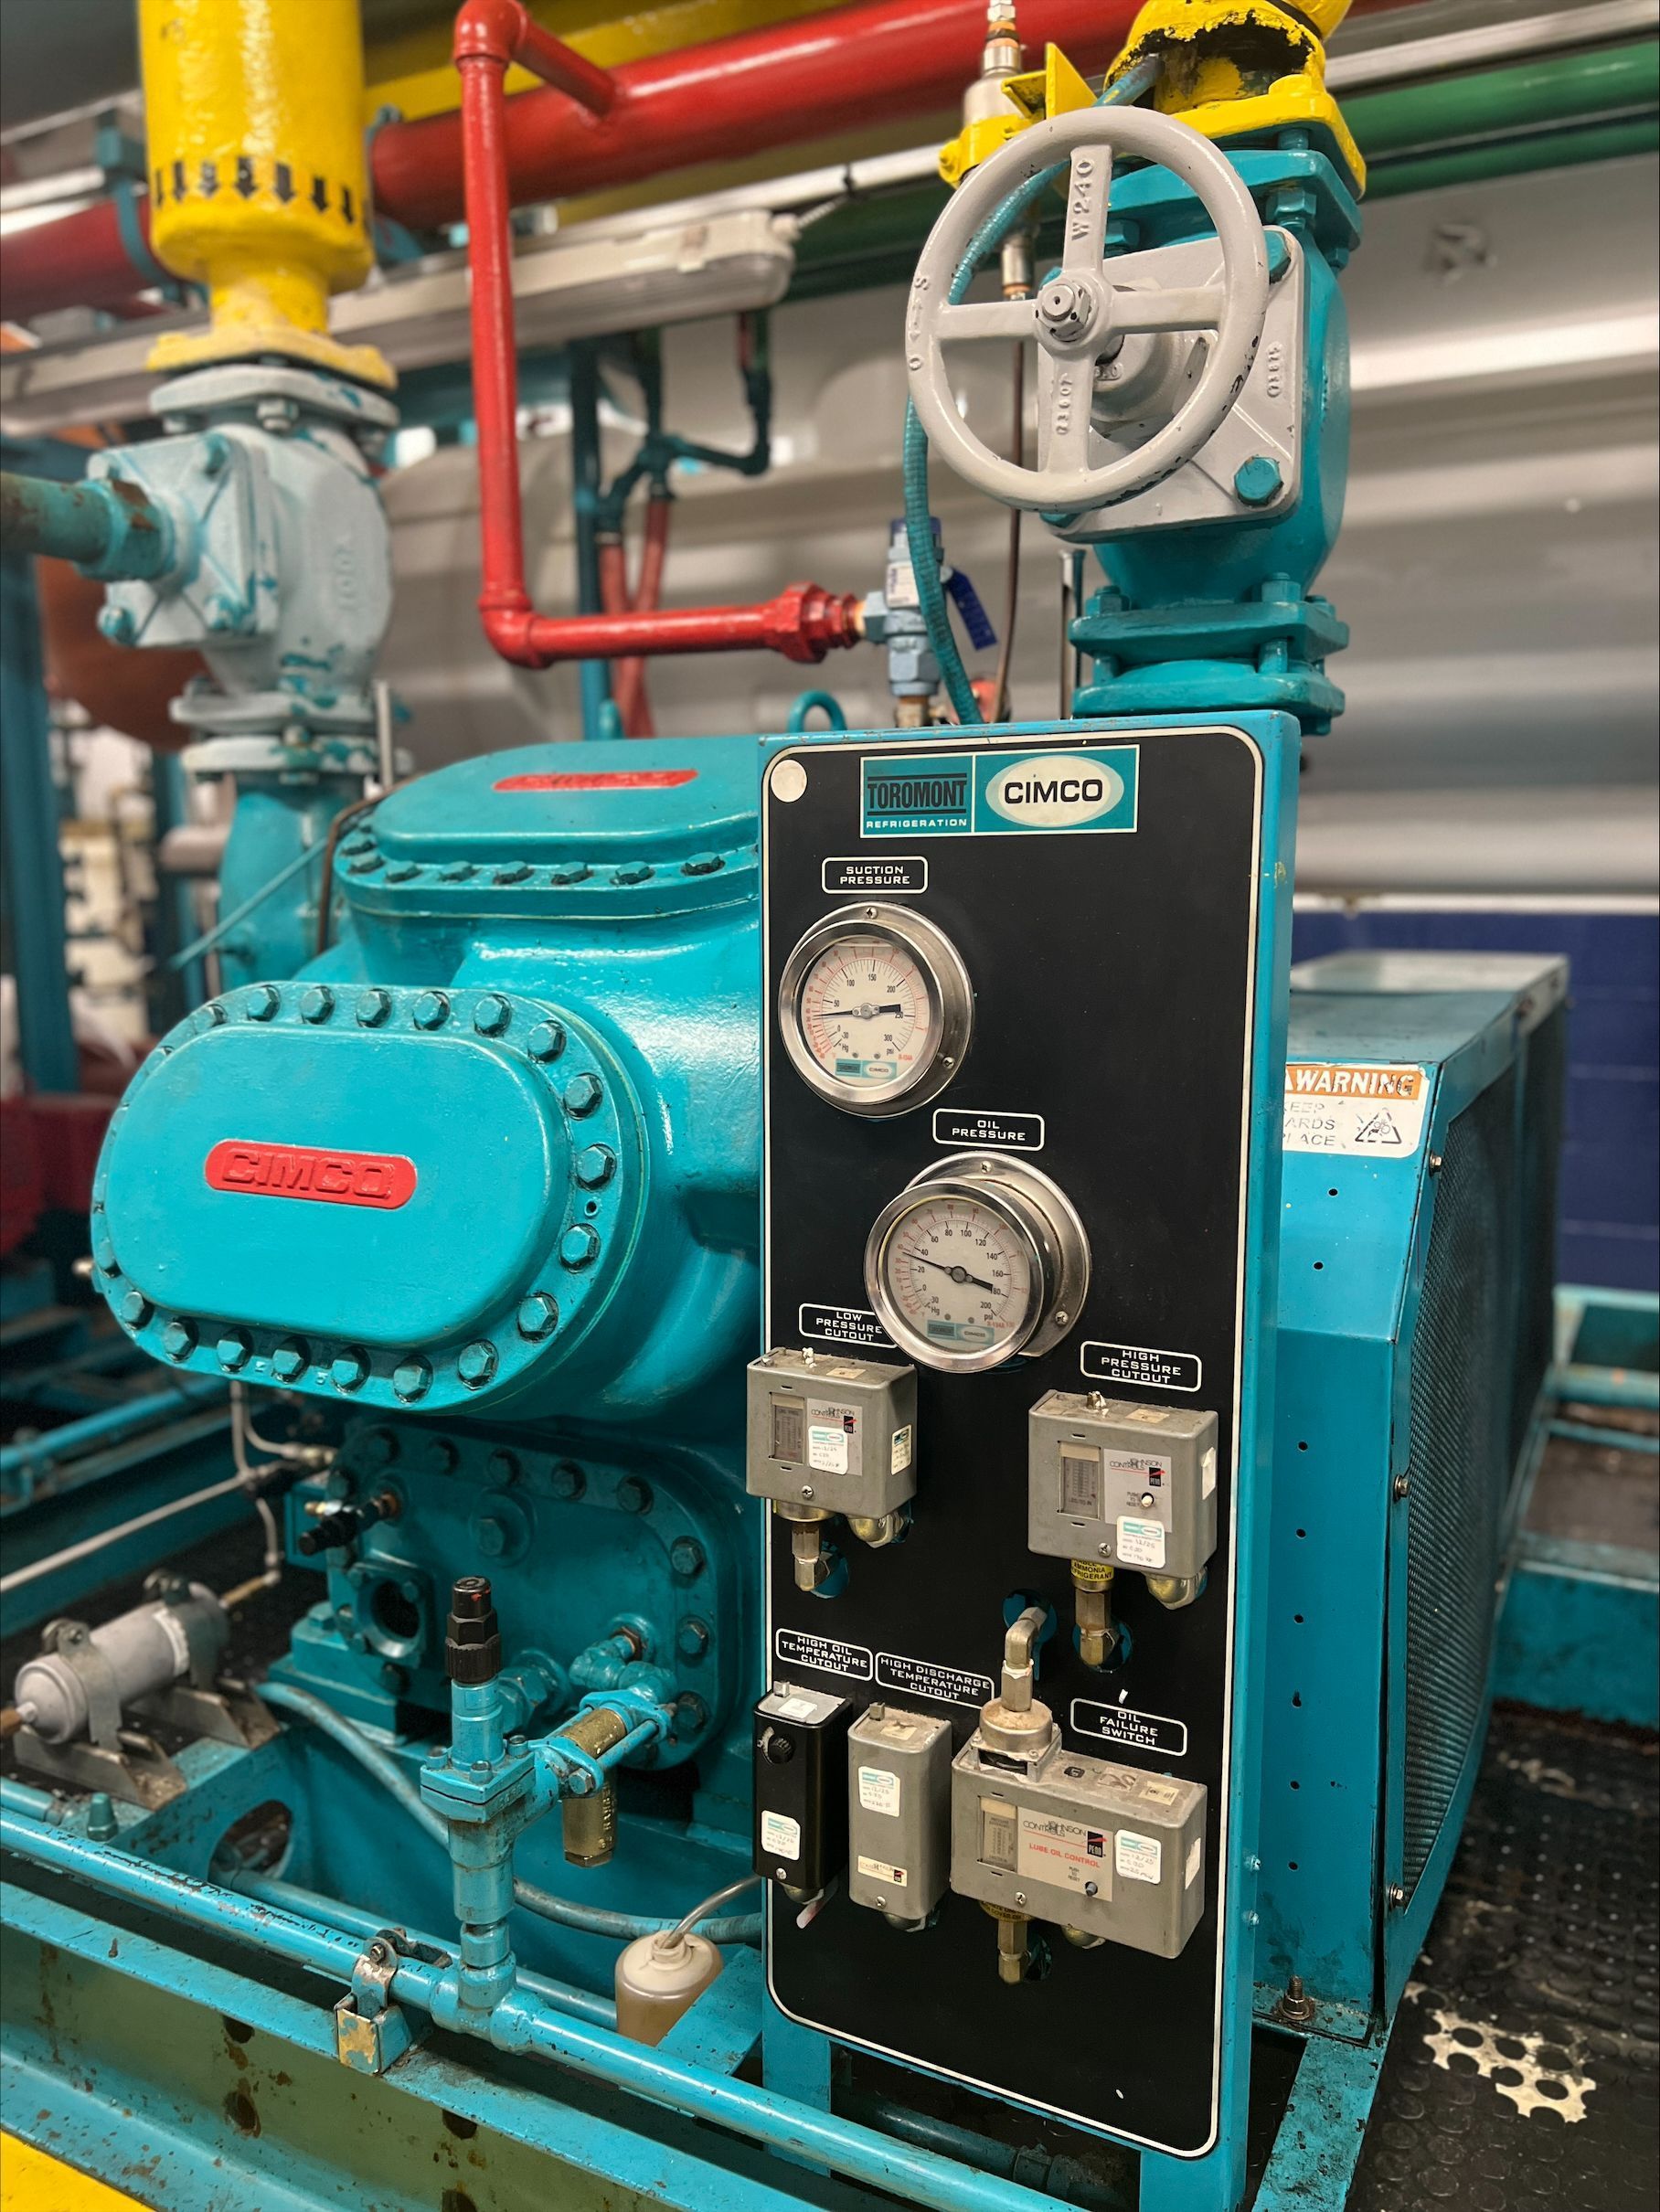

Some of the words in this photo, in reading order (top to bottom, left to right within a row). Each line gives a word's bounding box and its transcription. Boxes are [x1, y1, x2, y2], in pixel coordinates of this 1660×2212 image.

[1071, 159, 1094, 240] W240
[867, 781, 967, 809] TOROMONT
[1005, 779, 1102, 804] CIMCO
[867, 818, 967, 829] REFRIGERATION
[846, 866, 903, 875] SUCTION
[840, 876, 910, 885] PRESSURE
[1296, 1069, 1414, 1097] WARNING
[977, 1120, 1000, 1129] OIL
[952, 1128, 1026, 1141] PRESSURE
[222, 1148, 394, 1199] CIMCO
[816, 1317, 882, 1334] PRESSURE
[835, 1312, 862, 1321] LOW
[825, 1328, 874, 1341] CUTOUT
[1122, 1350, 1159, 1362] HIGH
[1101, 1356, 1181, 1376] PRESSURE
[1112, 1368, 1170, 1384] CUTOUT
[782, 1640, 867, 1668] TEMPERATURE
[797, 1636, 827, 1650] HIGH
[832, 1644, 852, 1655] OIL
[801, 1654, 848, 1672] CUTOUT
[880, 1657, 911, 1671] HIGH
[916, 1665, 990, 1689] DISCHARGE
[890, 1668, 978, 1696] TEMPERATURE
[910, 1682, 960, 1700] CUTOUT
[1117, 1711, 1141, 1723] OIL
[1100, 1716, 1158, 1737] FAILURE
[1101, 1727, 1155, 1745] SWITCH
[1029, 1843, 1048, 1854] LUBE
[1050, 1848, 1062, 1858] OIL
[1065, 1853, 1101, 1868] CONTROL
